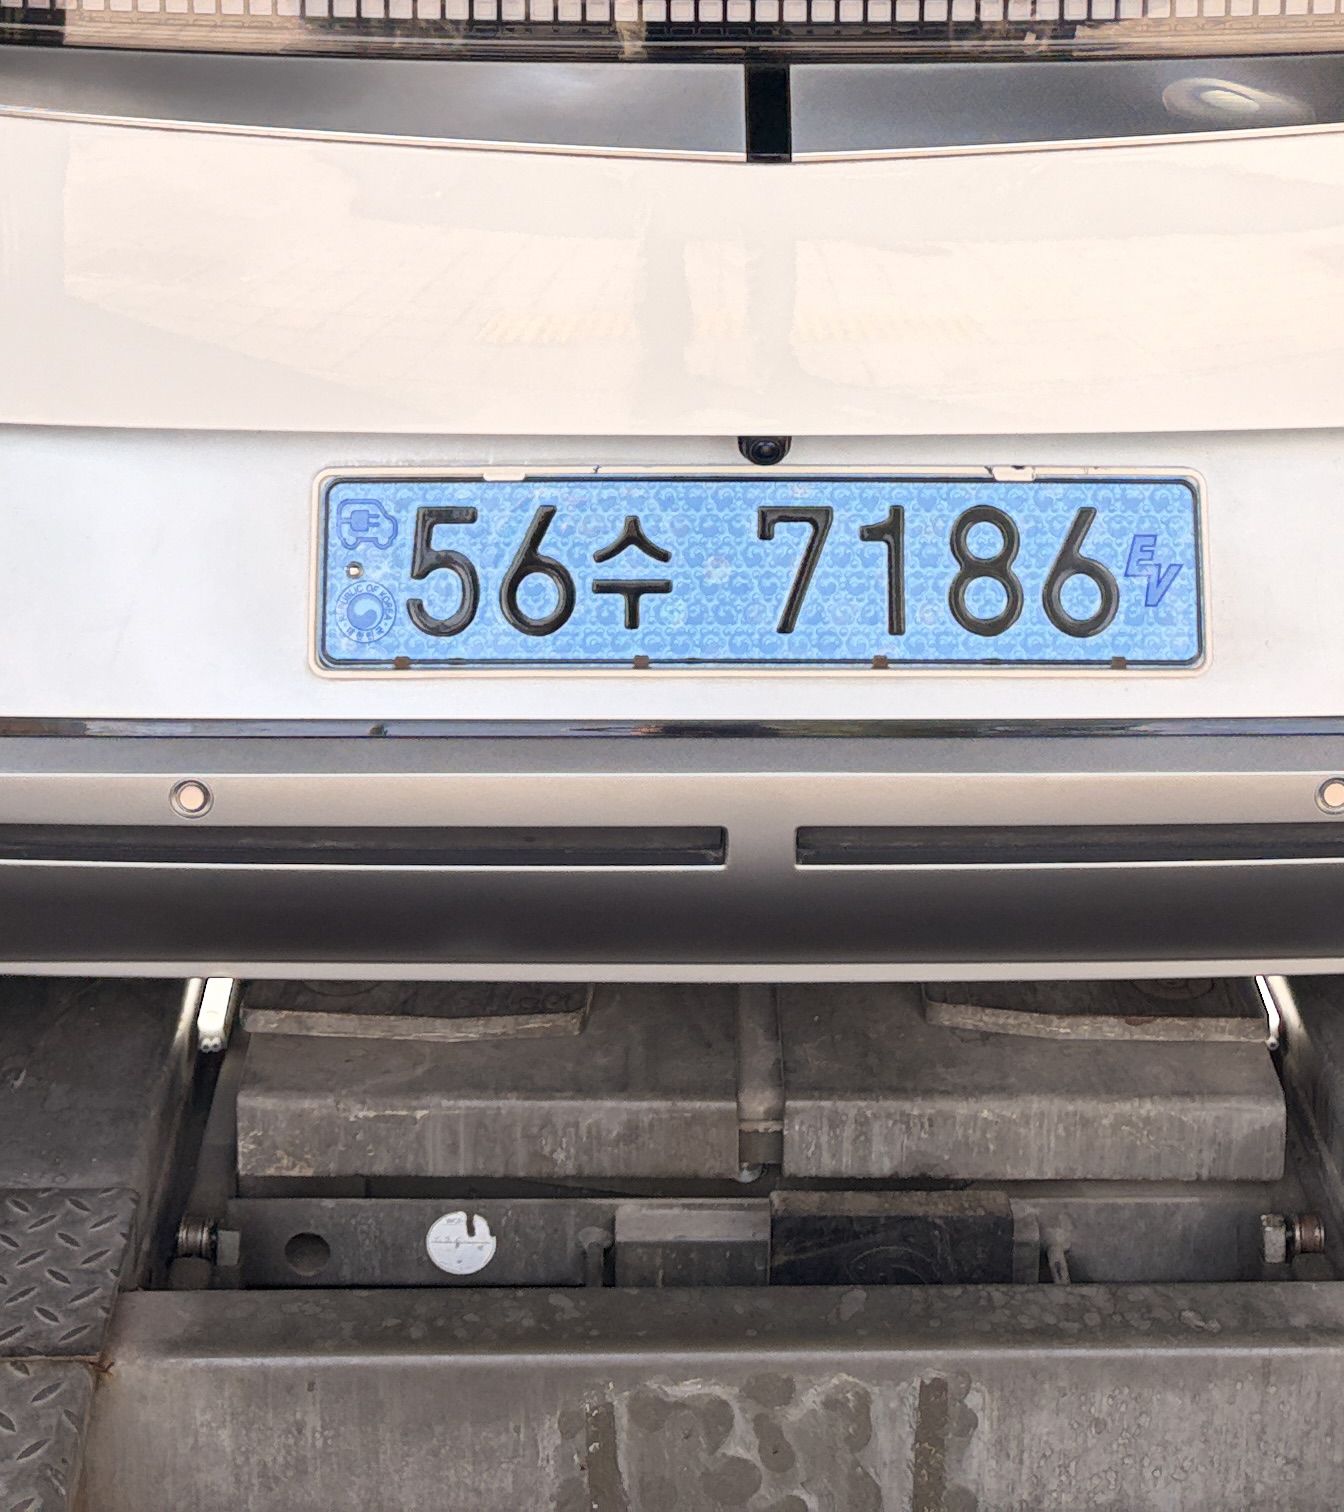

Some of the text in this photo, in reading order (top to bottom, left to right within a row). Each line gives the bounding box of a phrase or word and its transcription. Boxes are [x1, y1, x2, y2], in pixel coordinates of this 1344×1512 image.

[405, 504, 1120, 637] 56수 7186
[1124, 534, 1184, 607] EV
